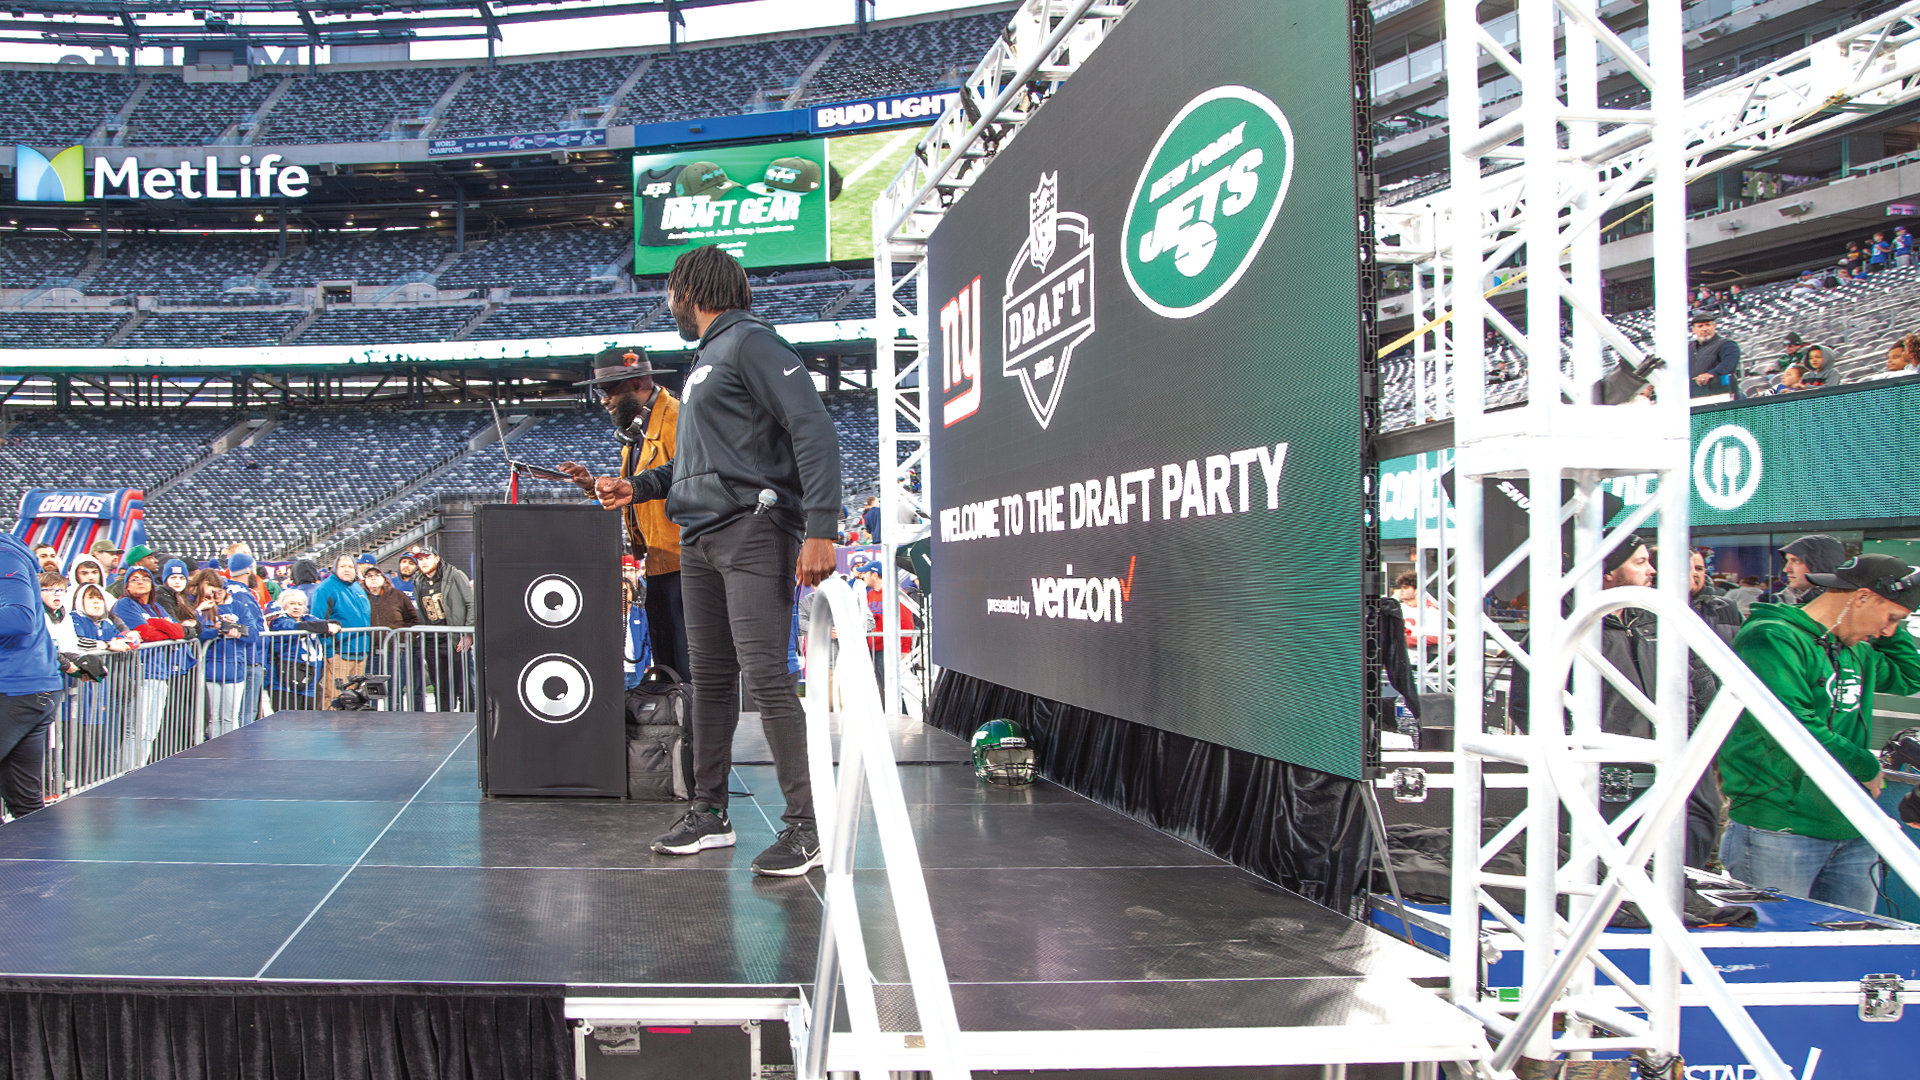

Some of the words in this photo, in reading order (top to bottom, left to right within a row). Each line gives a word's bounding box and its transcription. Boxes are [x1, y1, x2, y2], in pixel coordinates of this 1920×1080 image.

[817, 104, 875, 128] BUD
[428, 146, 463, 155] CHAMPIONS
[434, 140, 457, 148] WORLD
[93, 153, 310, 200] MetLife
[1149, 158, 1191, 204] NEW
[660, 198, 738, 230] DRAFT
[738, 195, 801, 225] GEAR
[1138, 147, 1264, 264] JETS
[1009, 268, 1084, 352] DRAFT
[38, 494, 107, 513] GIANTS
[940, 498, 1000, 543] WELCOME
[1001, 494, 1024, 536] TO
[1026, 486, 1065, 533] THE
[1069, 467, 1155, 529] DRAFT
[1161, 442, 1289, 520] PARTY
[1495, 481, 1530, 514] SHU
[987, 595, 1020, 615] presented
[1021, 595, 1031, 619] by
[1032, 563, 1123, 623] verizon
